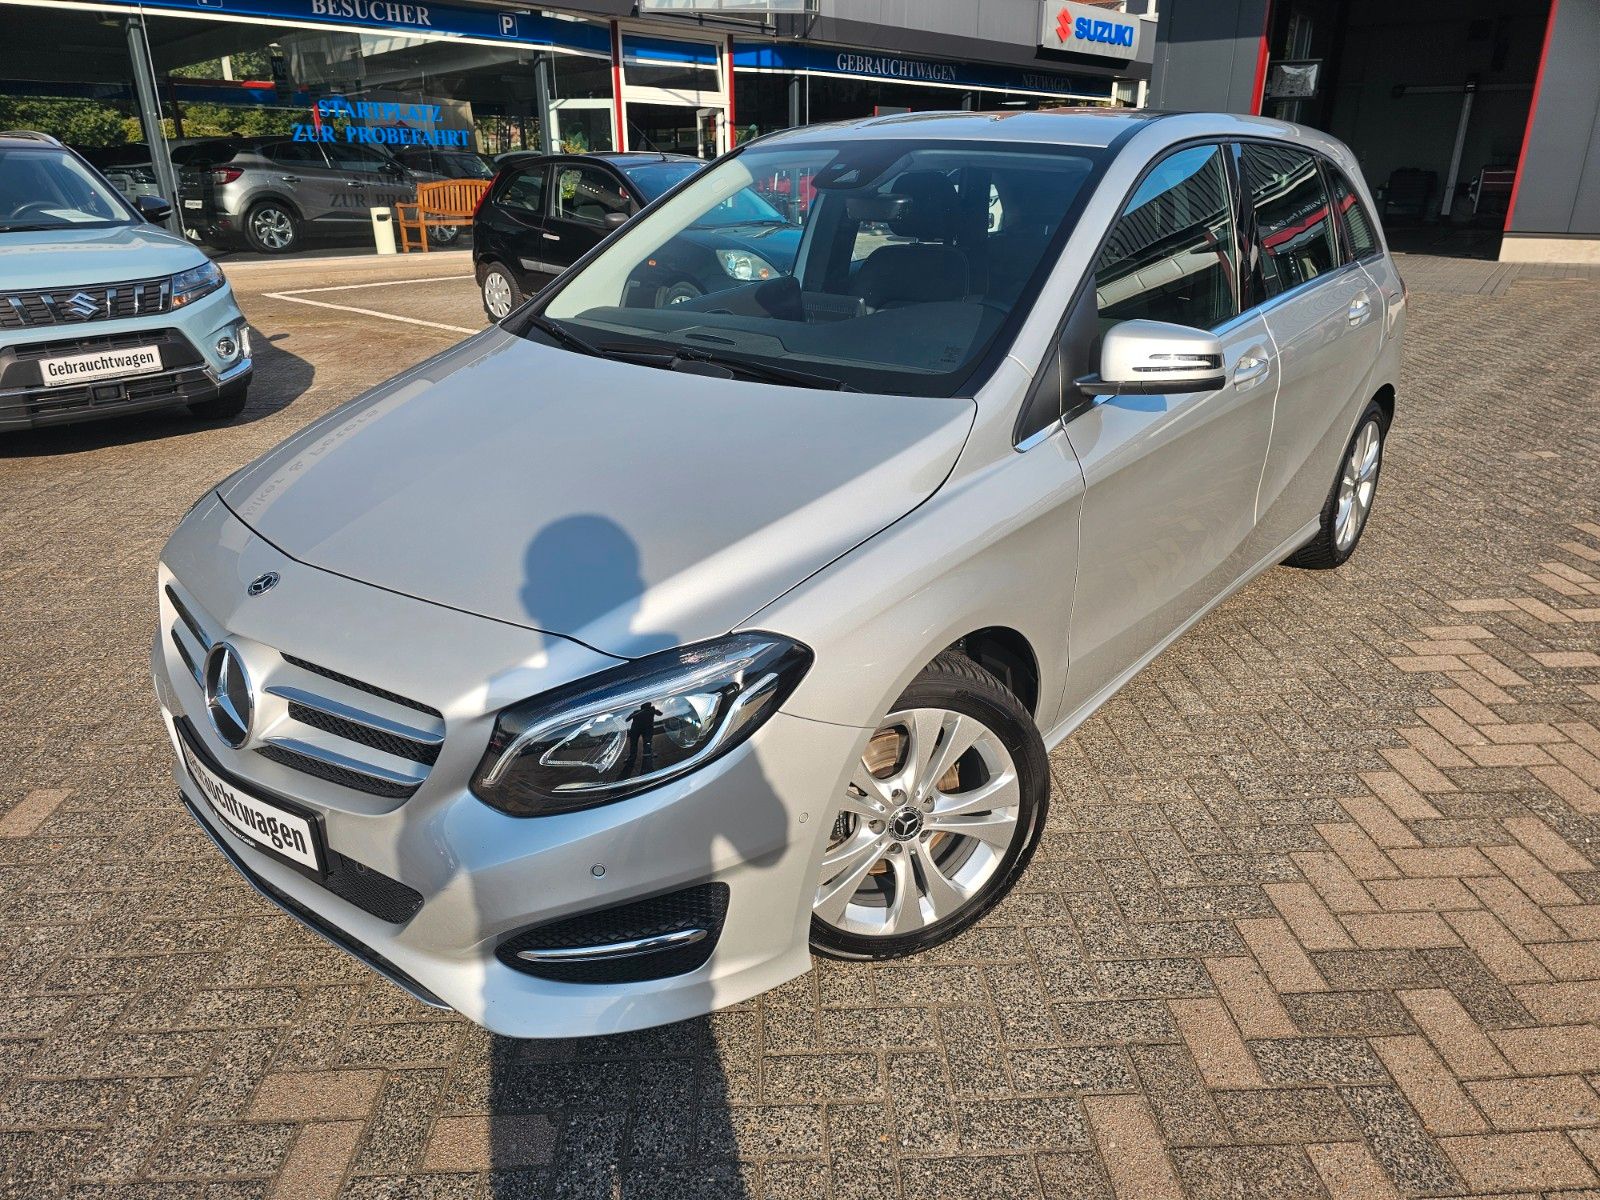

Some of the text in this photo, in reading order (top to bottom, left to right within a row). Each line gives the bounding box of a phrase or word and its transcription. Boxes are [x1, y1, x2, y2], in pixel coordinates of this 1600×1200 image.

[311, 0, 432, 26] BESUCHER
[1075, 16, 1134, 47] SUZUKI
[836, 52, 956, 81] GEBRAUCHTWAGEN
[318, 99, 443, 122] STARTPLATZ
[290, 122, 470, 147] ZUR PROBEFAHRT
[48, 352, 155, 377] Gebrauchtwagen
